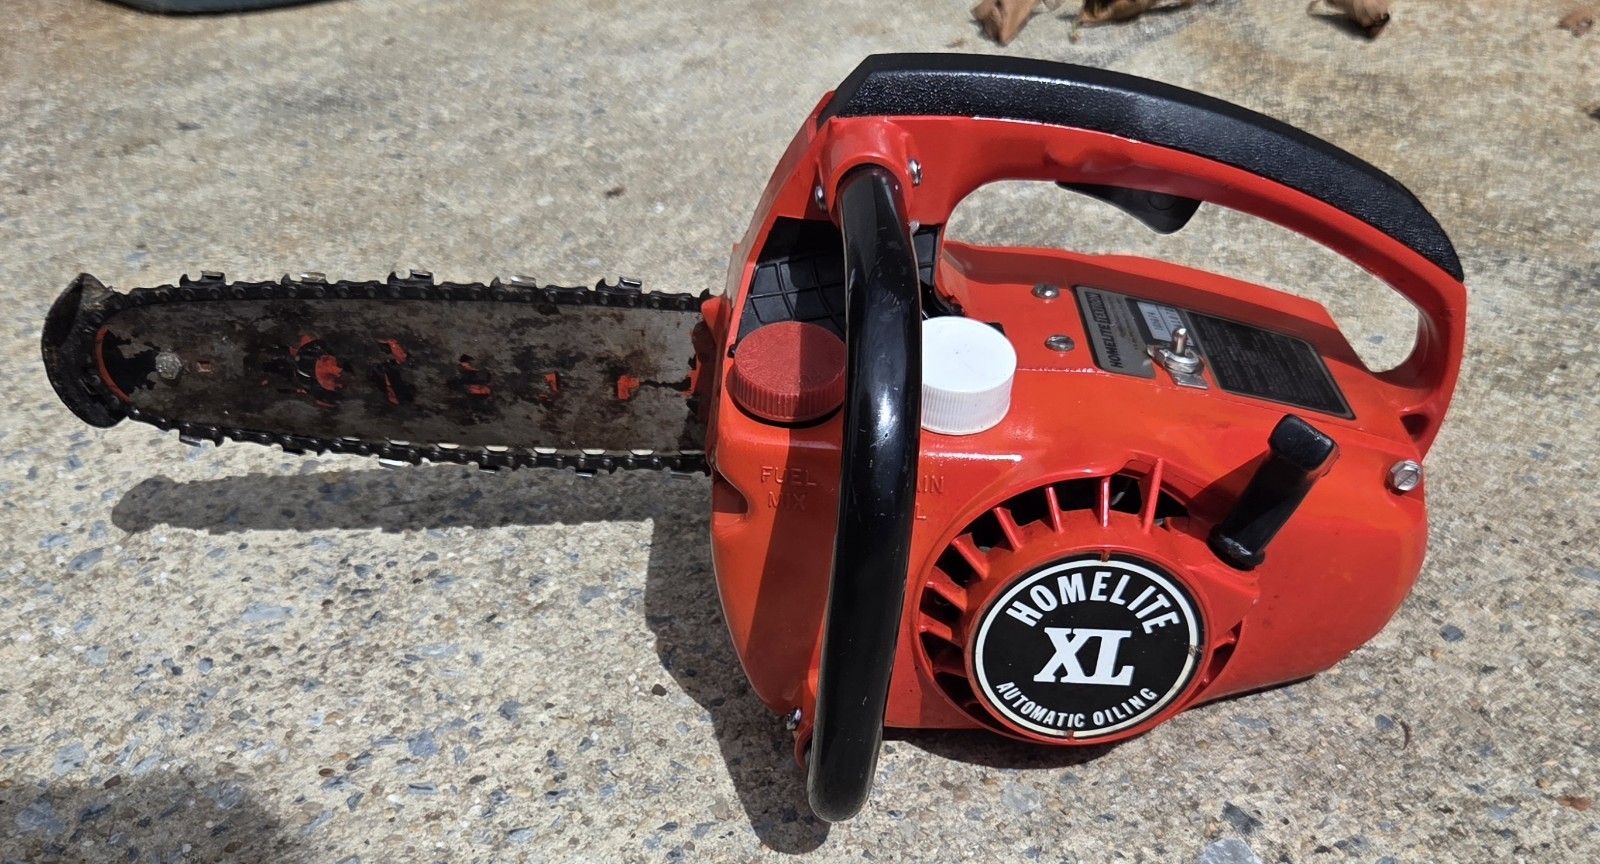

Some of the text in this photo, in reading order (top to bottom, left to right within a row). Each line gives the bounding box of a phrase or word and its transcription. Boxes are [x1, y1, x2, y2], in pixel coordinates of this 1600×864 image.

[1086, 292, 1111, 324] TEXTRON
[1098, 323, 1124, 369] HOMELITE
[760, 465, 817, 486] FUEL
[767, 491, 806, 510] MIX
[1005, 571, 1181, 634] HOMELITE
[1033, 627, 1135, 686] XL
[996, 681, 1159, 728] AUTOMATIC OILING
